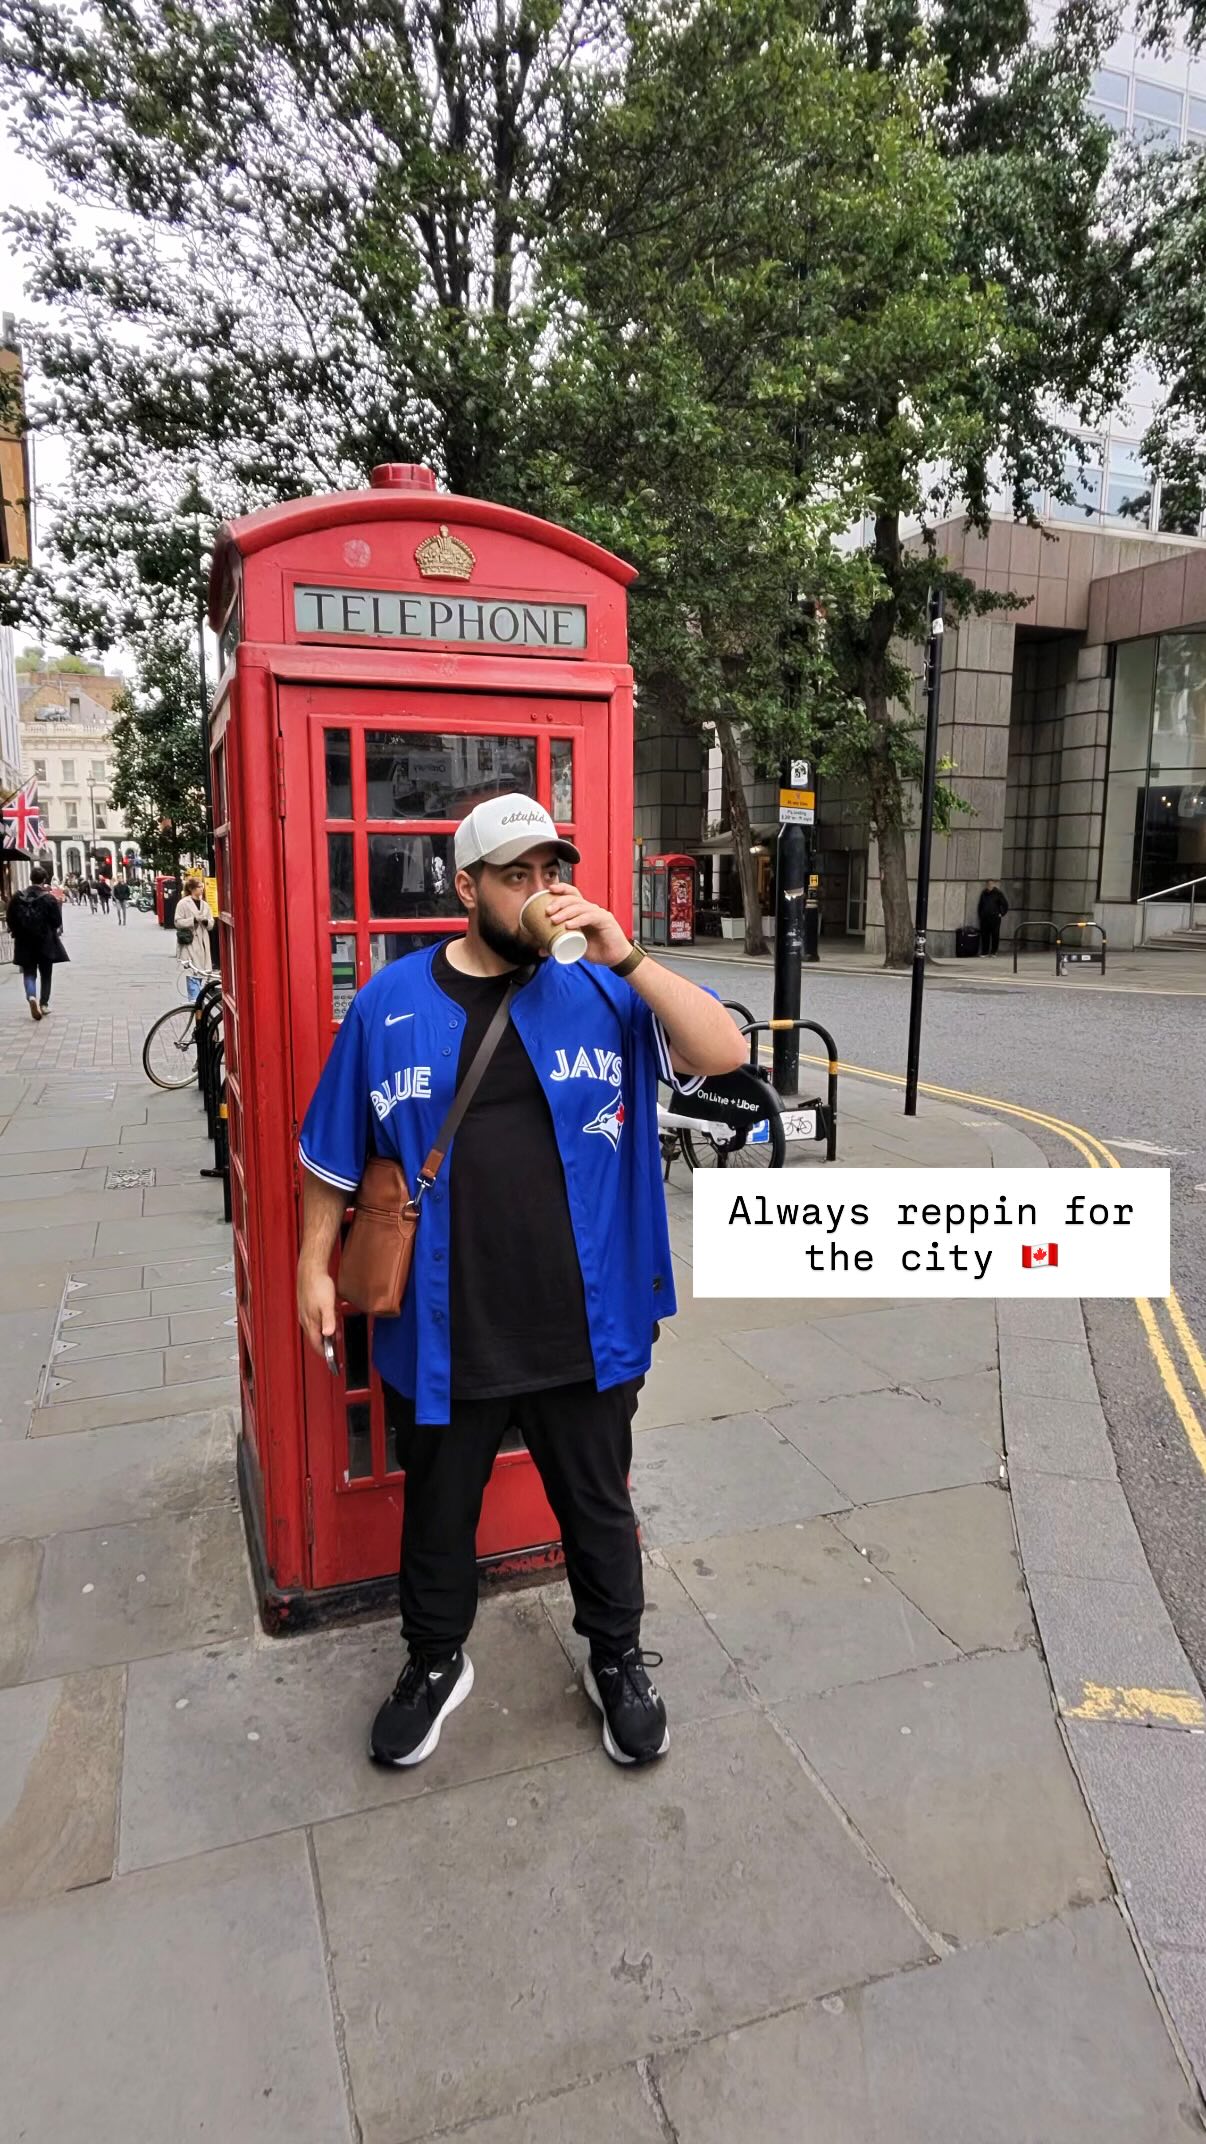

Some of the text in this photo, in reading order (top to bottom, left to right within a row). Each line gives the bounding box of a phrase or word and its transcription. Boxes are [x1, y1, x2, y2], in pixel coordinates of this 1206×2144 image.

[303, 591, 573, 645] TELEPHONE
[550, 1046, 623, 1087] JAYS
[370, 1066, 432, 1122] BLUE
[697, 1089, 709, 1100] On
[736, 1098, 760, 1112] Uber
